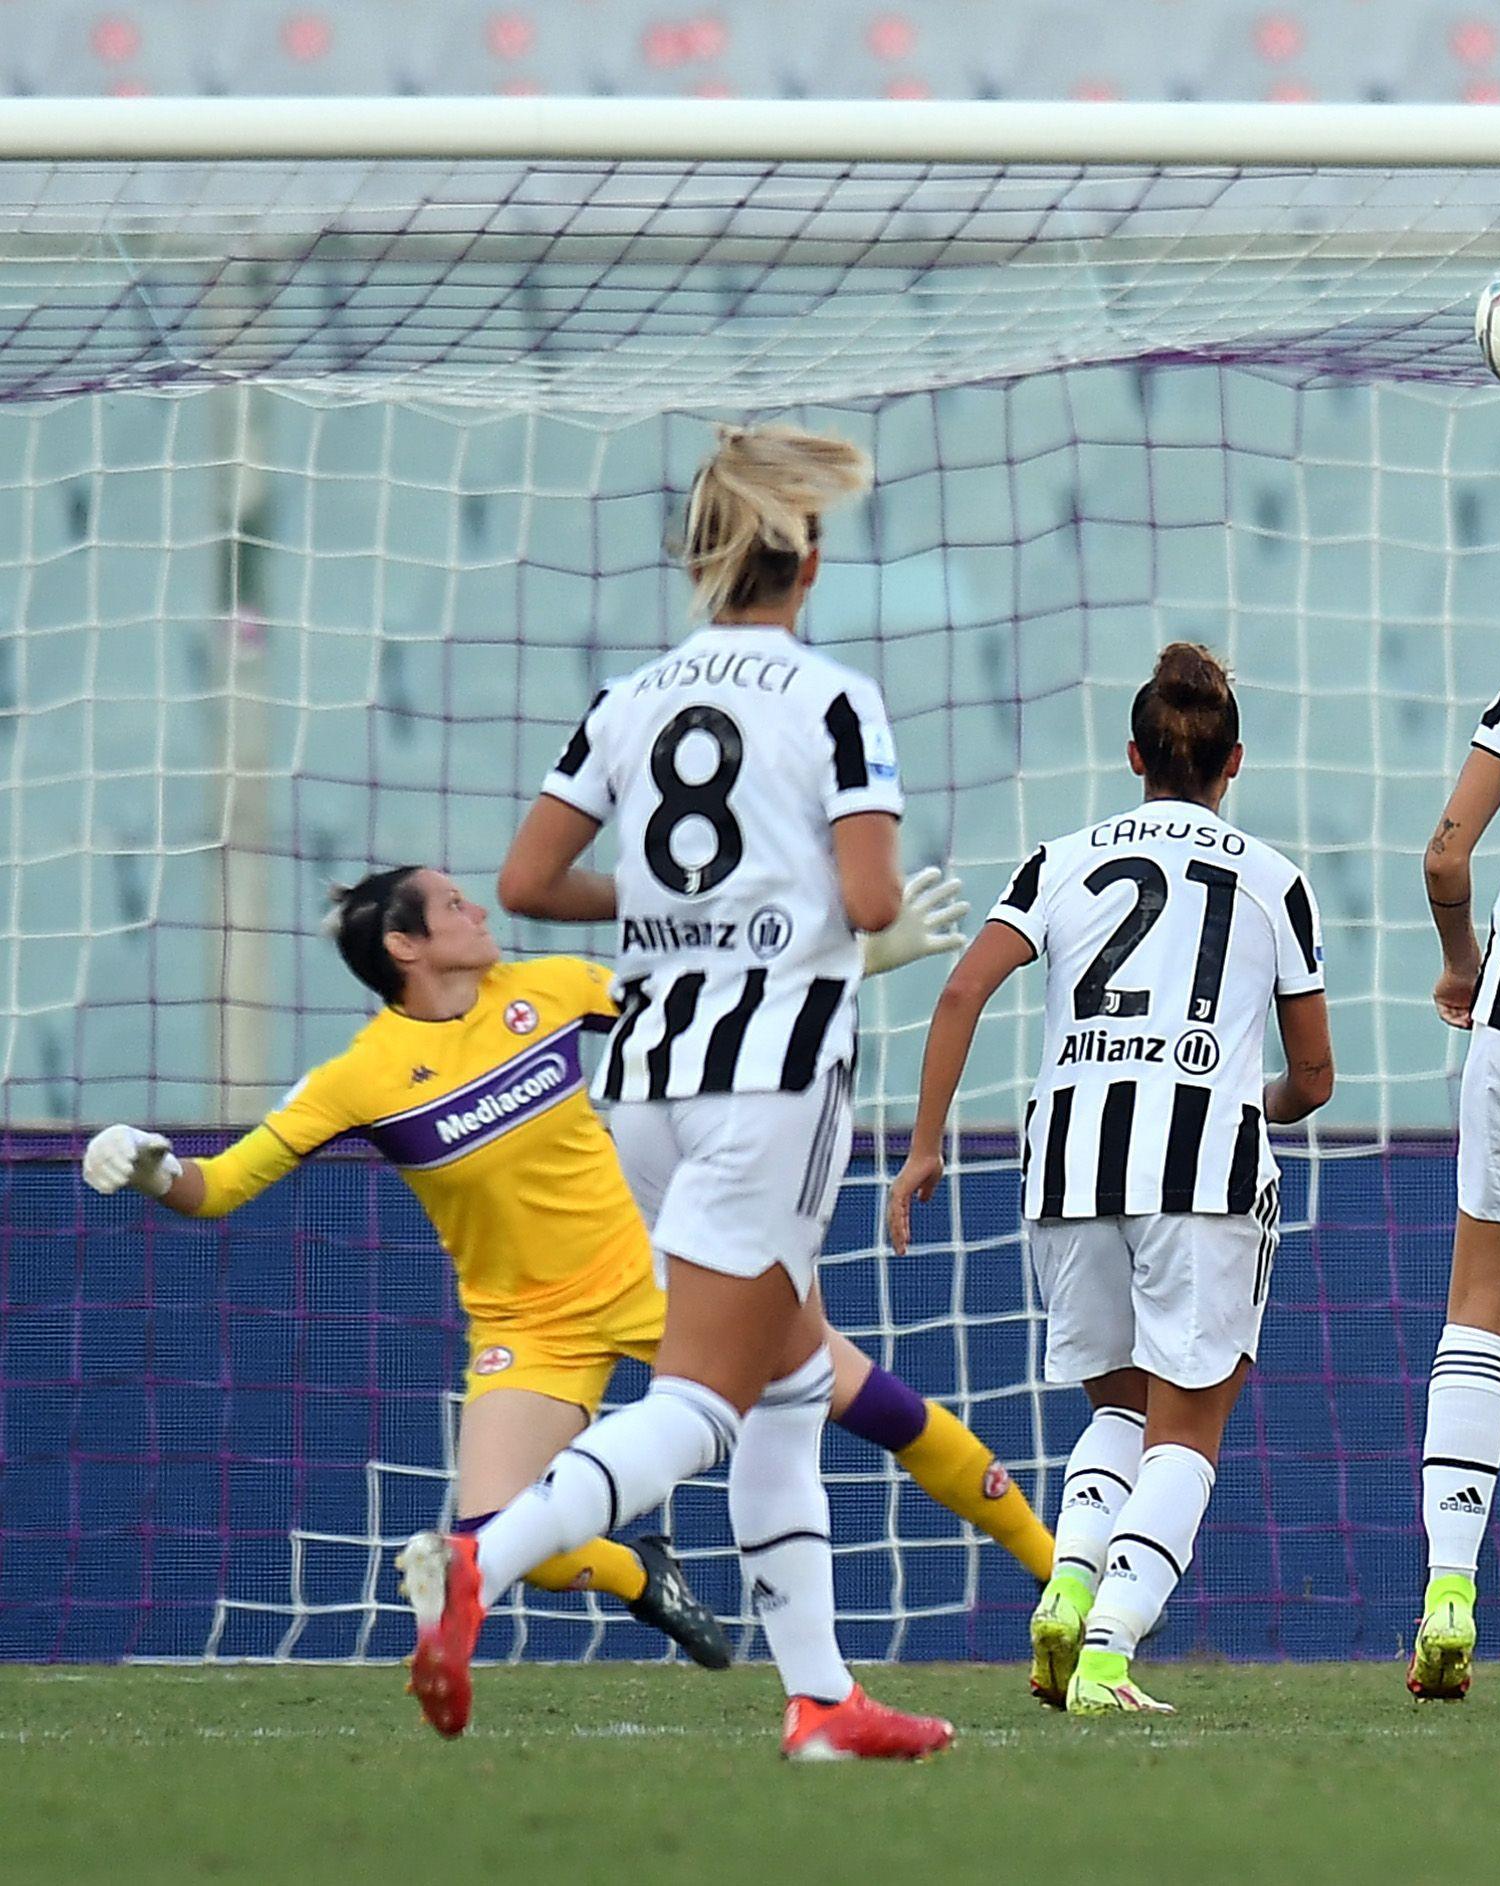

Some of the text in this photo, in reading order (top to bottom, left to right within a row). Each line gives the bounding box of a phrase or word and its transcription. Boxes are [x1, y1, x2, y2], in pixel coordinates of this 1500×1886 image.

[645, 705, 743, 896] 8
[1091, 819, 1245, 856] CARUSO
[1074, 856, 1238, 1024] 21
[1057, 1030, 1166, 1066] Allianz
[435, 1066, 561, 1144] Mediacom
